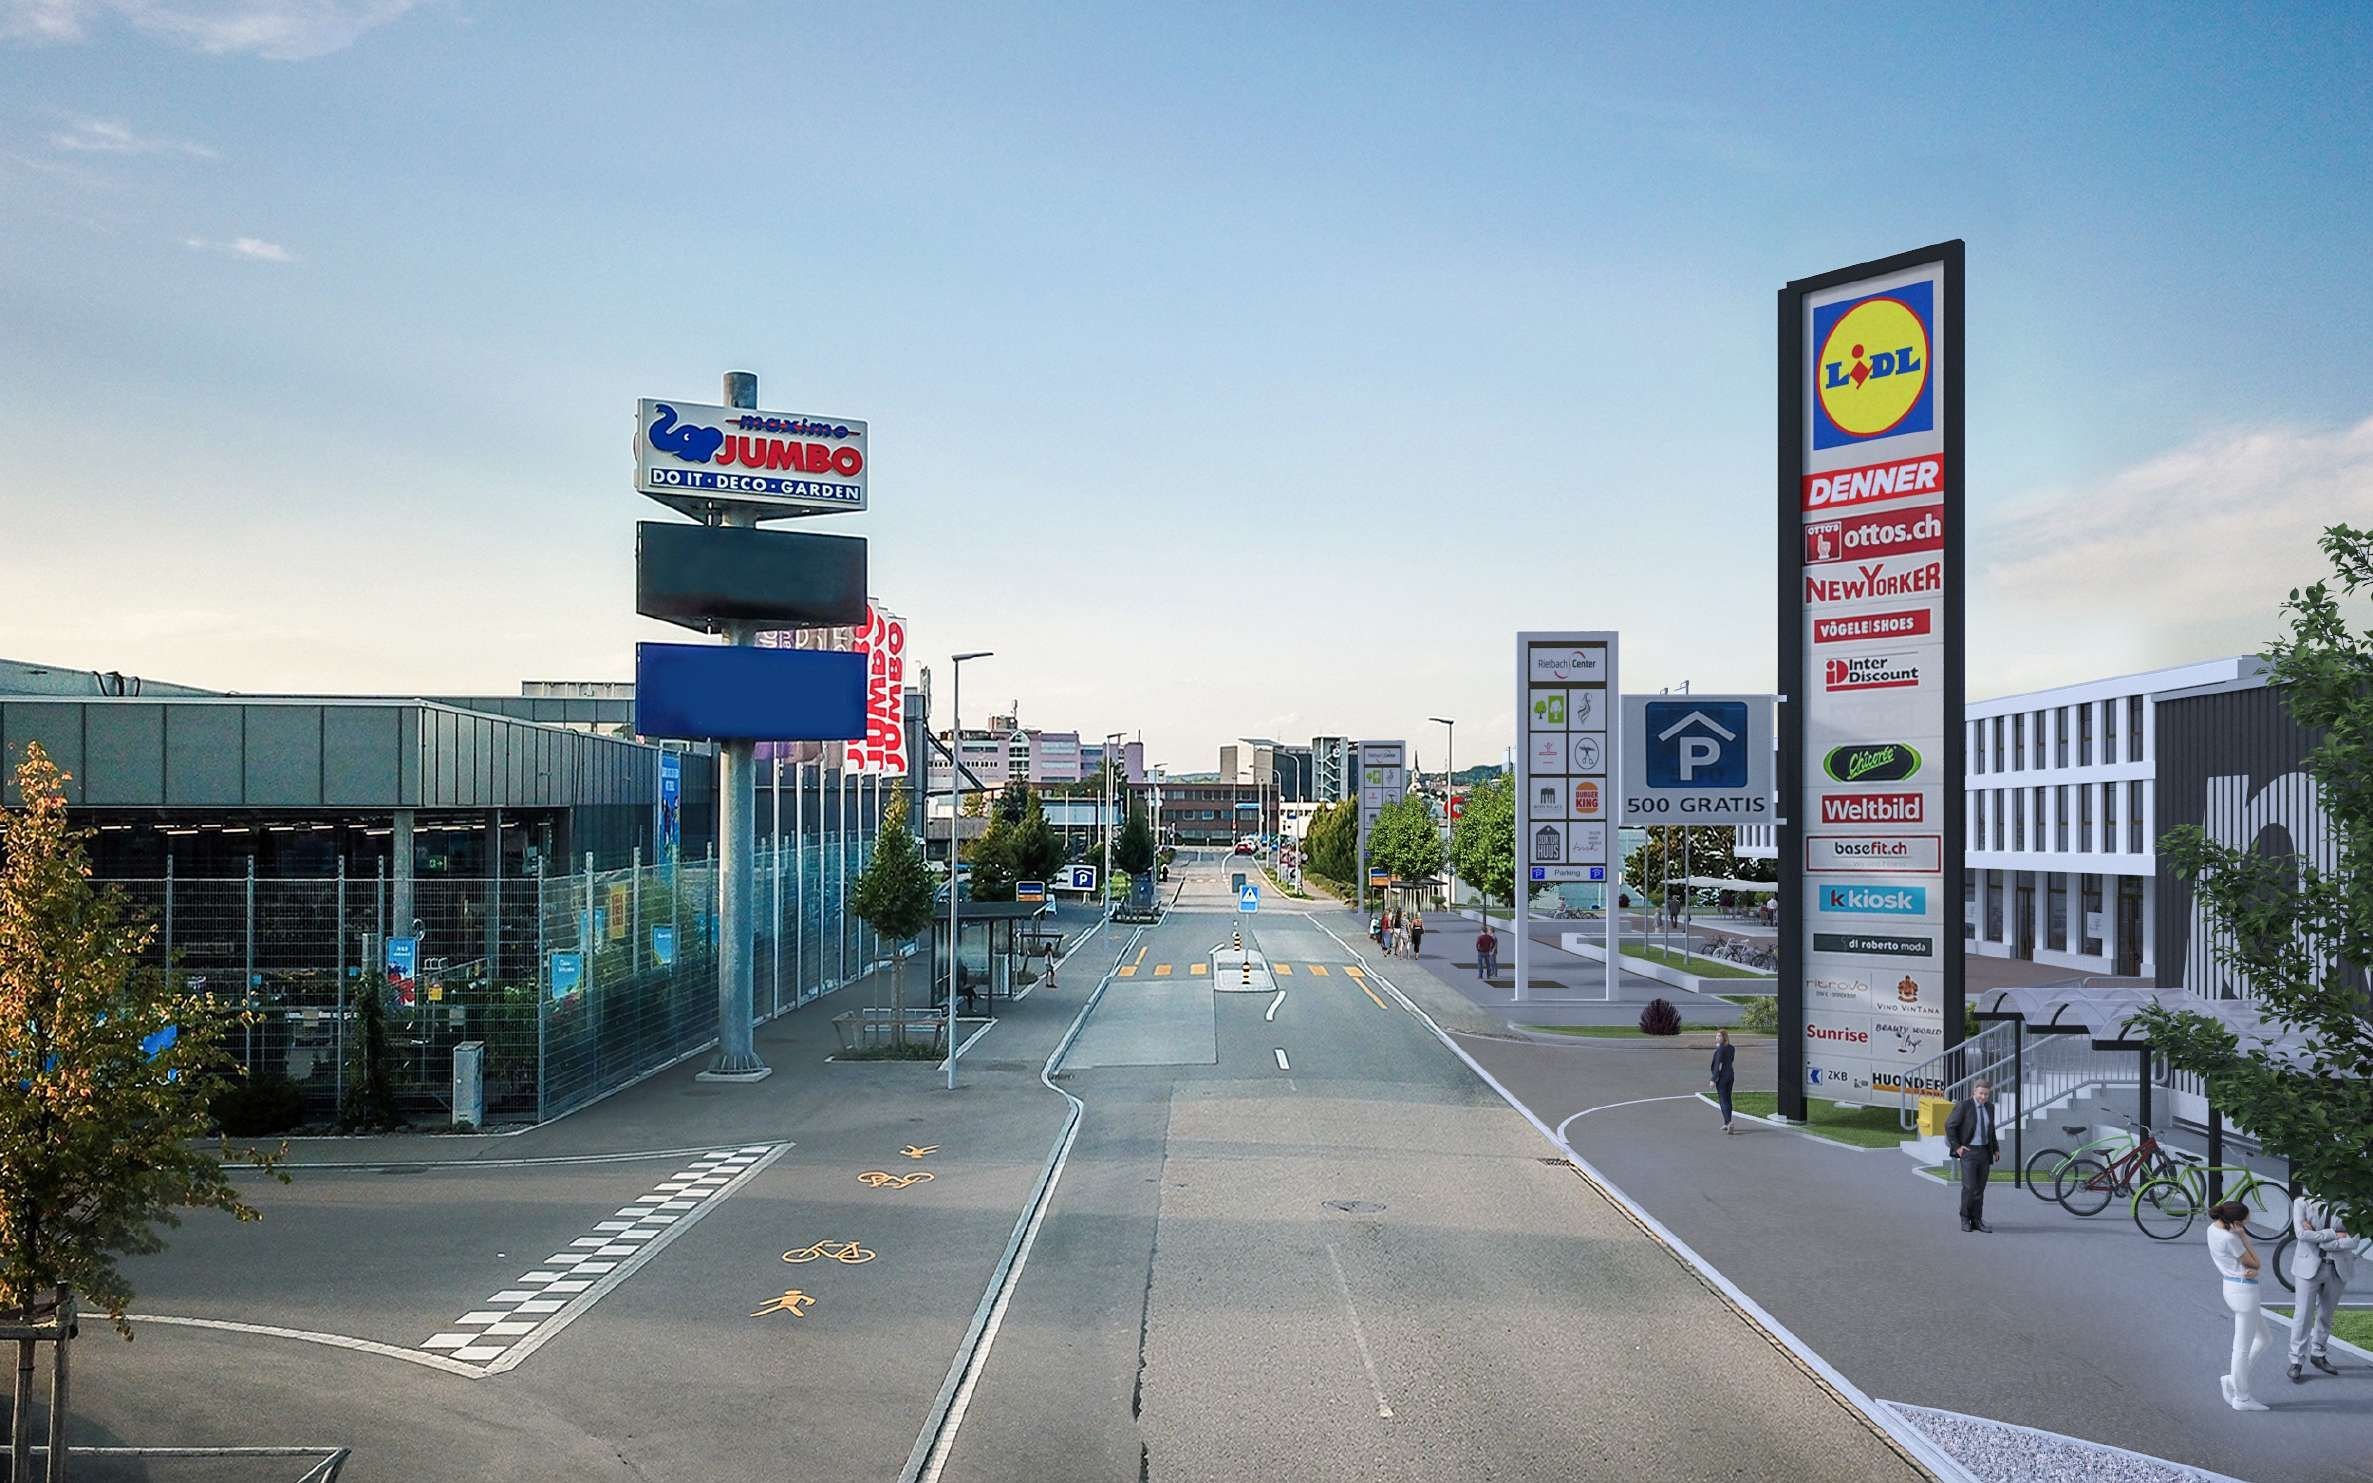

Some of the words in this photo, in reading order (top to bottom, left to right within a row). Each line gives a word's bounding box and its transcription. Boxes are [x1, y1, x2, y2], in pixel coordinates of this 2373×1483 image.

[739, 415, 849, 439] maximo
[715, 434, 863, 477] JUMBO
[653, 469, 681, 485] DO
[687, 472, 703, 486] IT
[716, 475, 767, 491] DECO
[781, 480, 859, 500] GARDEN
[1808, 460, 1940, 506] DENNER
[1844, 512, 1941, 548] ottos.ch
[1873, 616, 1914, 633] SHOES
[1572, 659, 1596, 669] Center
[1849, 657, 1888, 671] Inter
[1849, 667, 1919, 683] Discount
[883, 622, 906, 773] JUMBO
[1679, 736, 1721, 781] P
[1575, 799, 1599, 808] KING
[1627, 797, 1670, 813] 500
[1680, 797, 1766, 813] GRATIS
[1825, 797, 1921, 820] Weltbild
[1537, 845, 1559, 859] HUUS
[1834, 842, 1907, 856] basefit.ch
[1554, 869, 1581, 878] Parking
[1848, 889, 1912, 910] kiosk
[1861, 939, 1899, 951] roberto
[1900, 941, 1926, 952] moda
[1806, 1024, 1869, 1044] Sunrise
